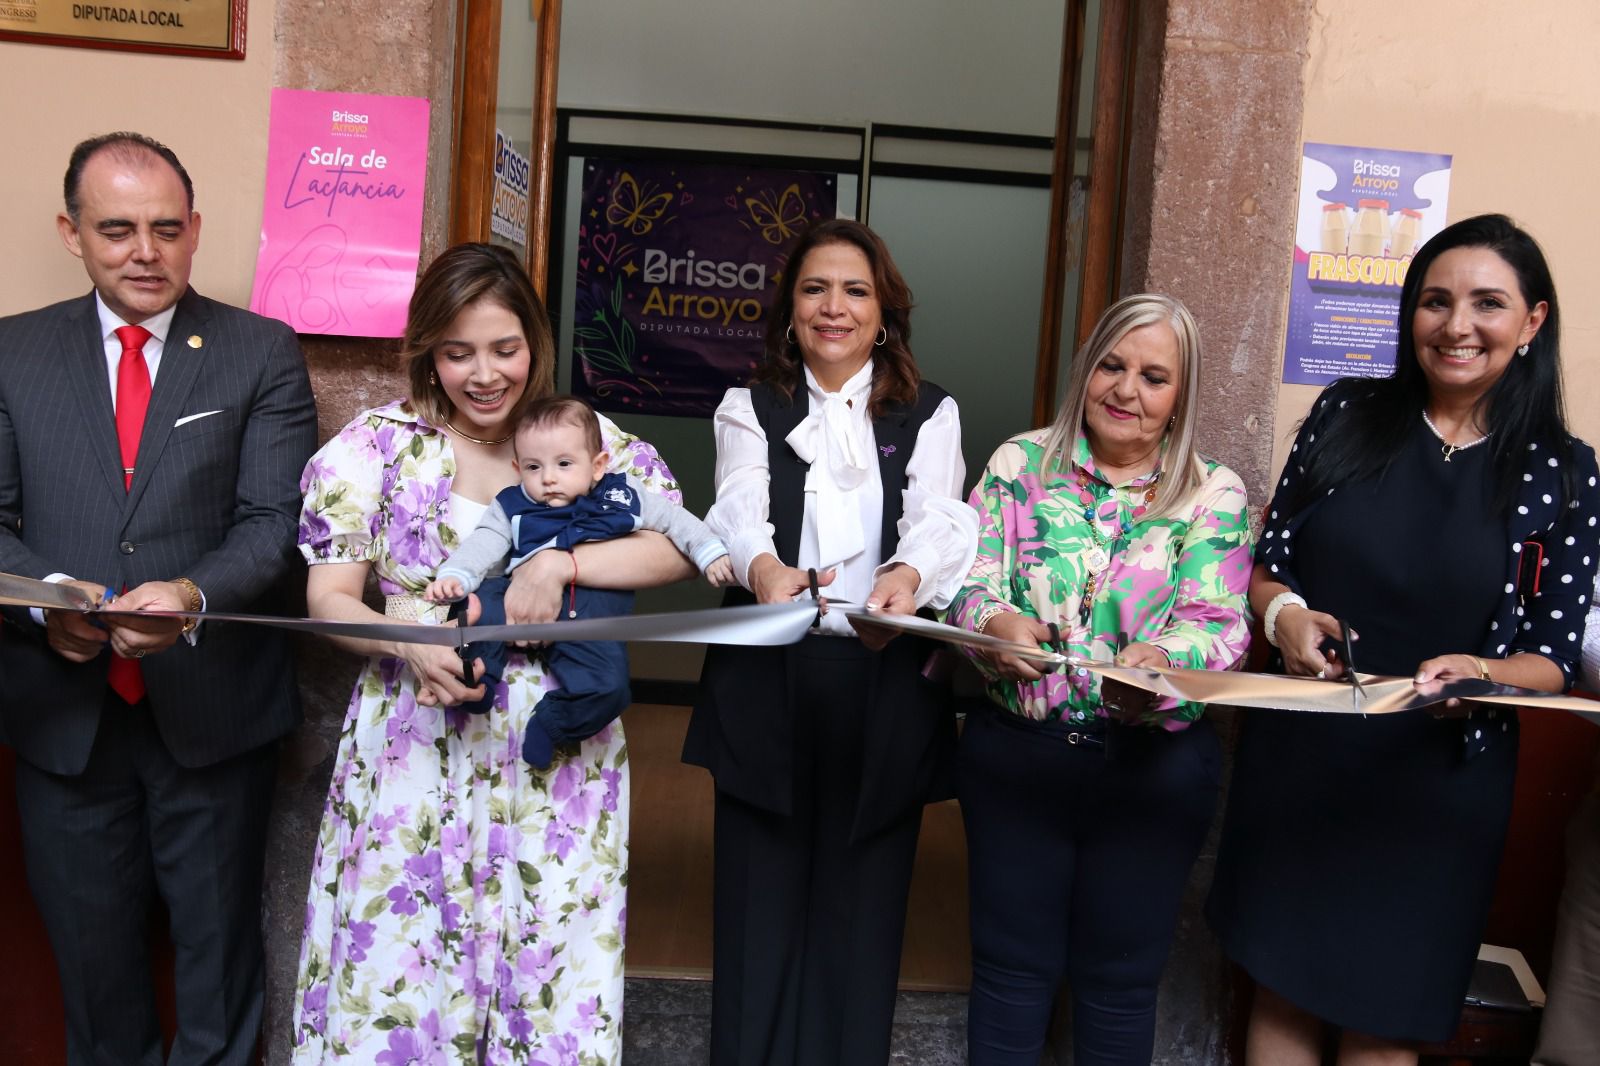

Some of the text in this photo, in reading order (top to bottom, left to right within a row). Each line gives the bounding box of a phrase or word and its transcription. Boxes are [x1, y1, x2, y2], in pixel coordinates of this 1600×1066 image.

[0, 7, 37, 18] NGRESO
[73, 4, 184, 28] DIPUTADA LOCAL
[332, 110, 368, 124] Brissa
[332, 122, 368, 134] Arroyo
[308, 146, 387, 168] Sala de
[496, 132, 528, 191] Brissa
[1353, 160, 1400, 178] Brissa
[284, 152, 404, 218] Lactancia
[1352, 174, 1399, 192] Arroyo
[494, 180, 528, 228] Arroyo
[644, 248, 766, 290] Brissa
[1308, 252, 1410, 288] FRASCOTÓ
[641, 286, 762, 326] Arroyo
[640, 322, 762, 338] DIPUTADA LOCAL
